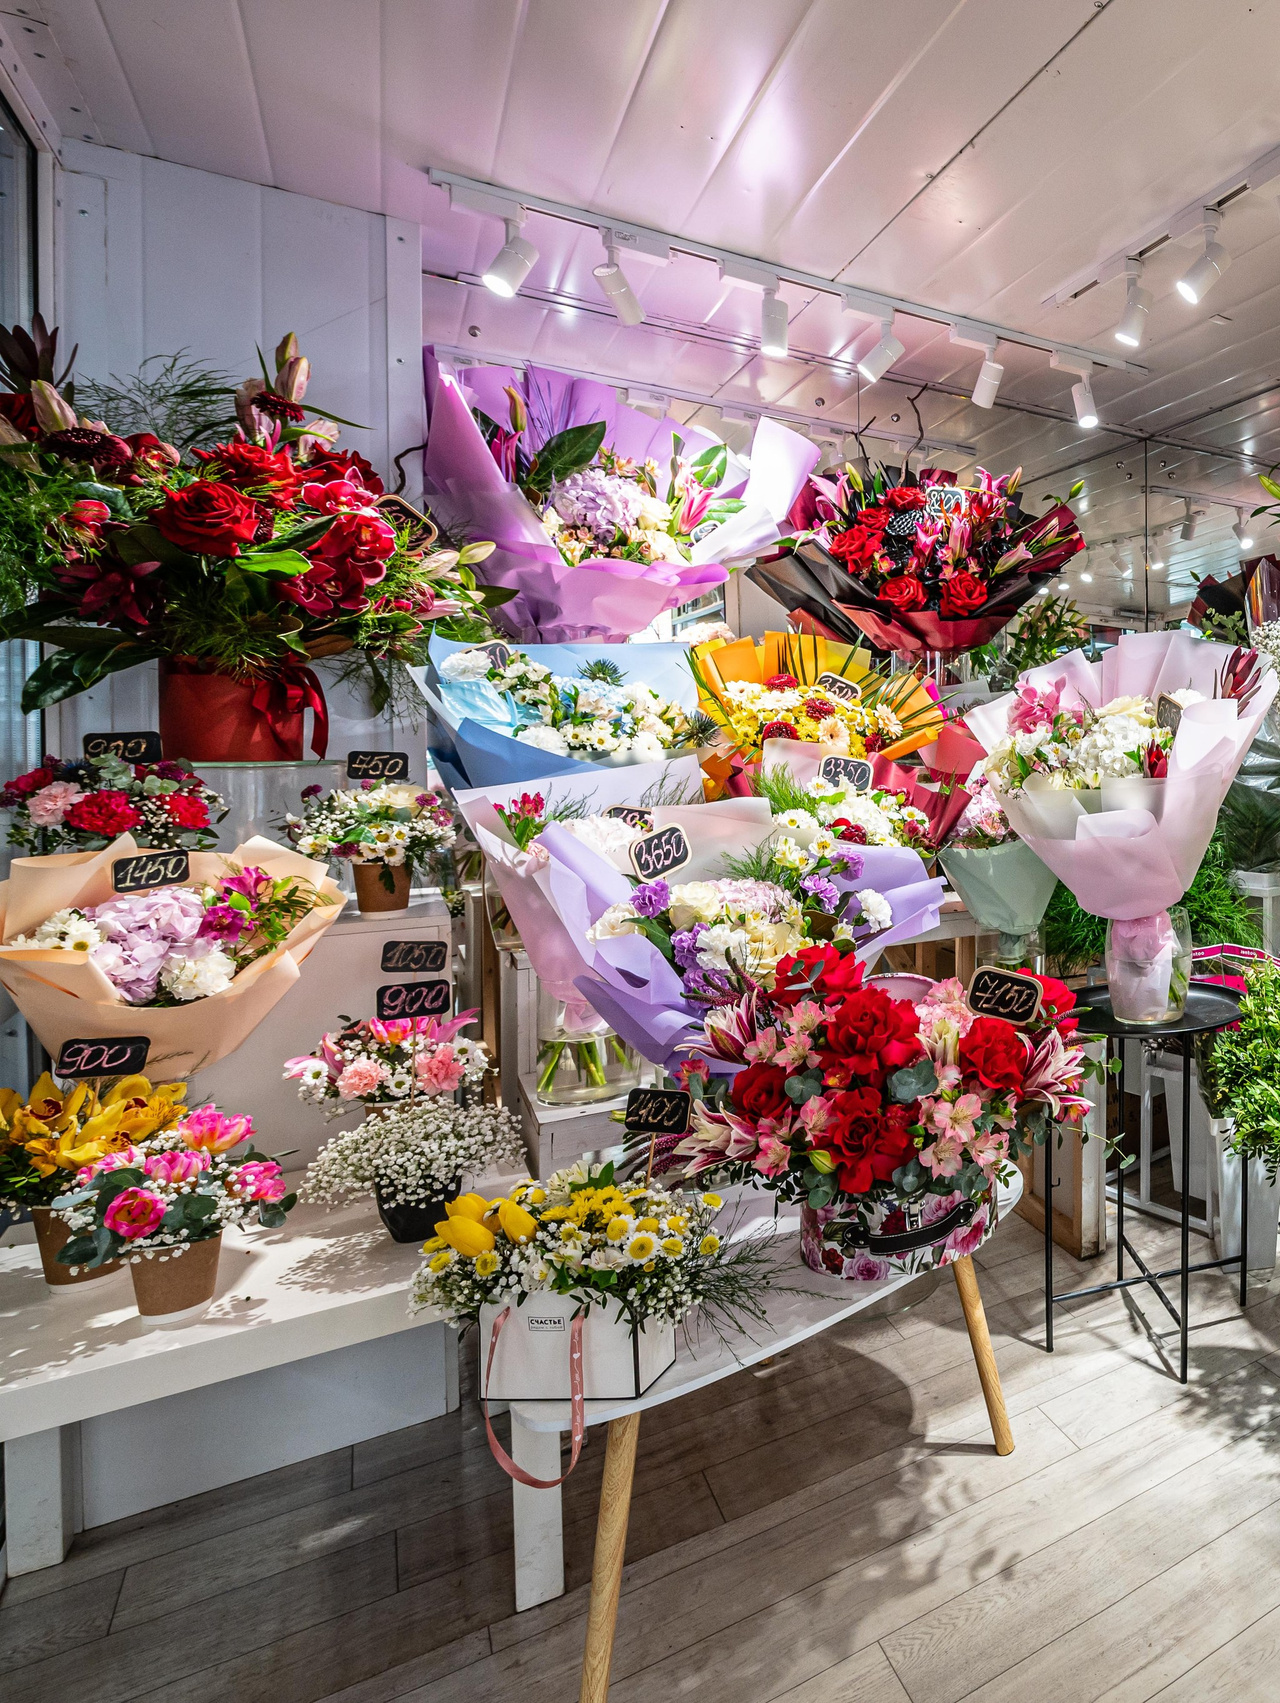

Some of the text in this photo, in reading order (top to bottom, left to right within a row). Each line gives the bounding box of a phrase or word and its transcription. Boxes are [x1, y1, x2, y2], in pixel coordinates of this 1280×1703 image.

[352, 754, 404, 776] 750
[823, 758, 869, 785] 3350
[635, 831, 684, 875] 3650
[117, 855, 187, 888] 1450
[382, 942, 446, 969] 1050
[383, 984, 448, 1016] 900
[975, 975, 1037, 1013] 7150
[56, 1044, 131, 1074] 900
